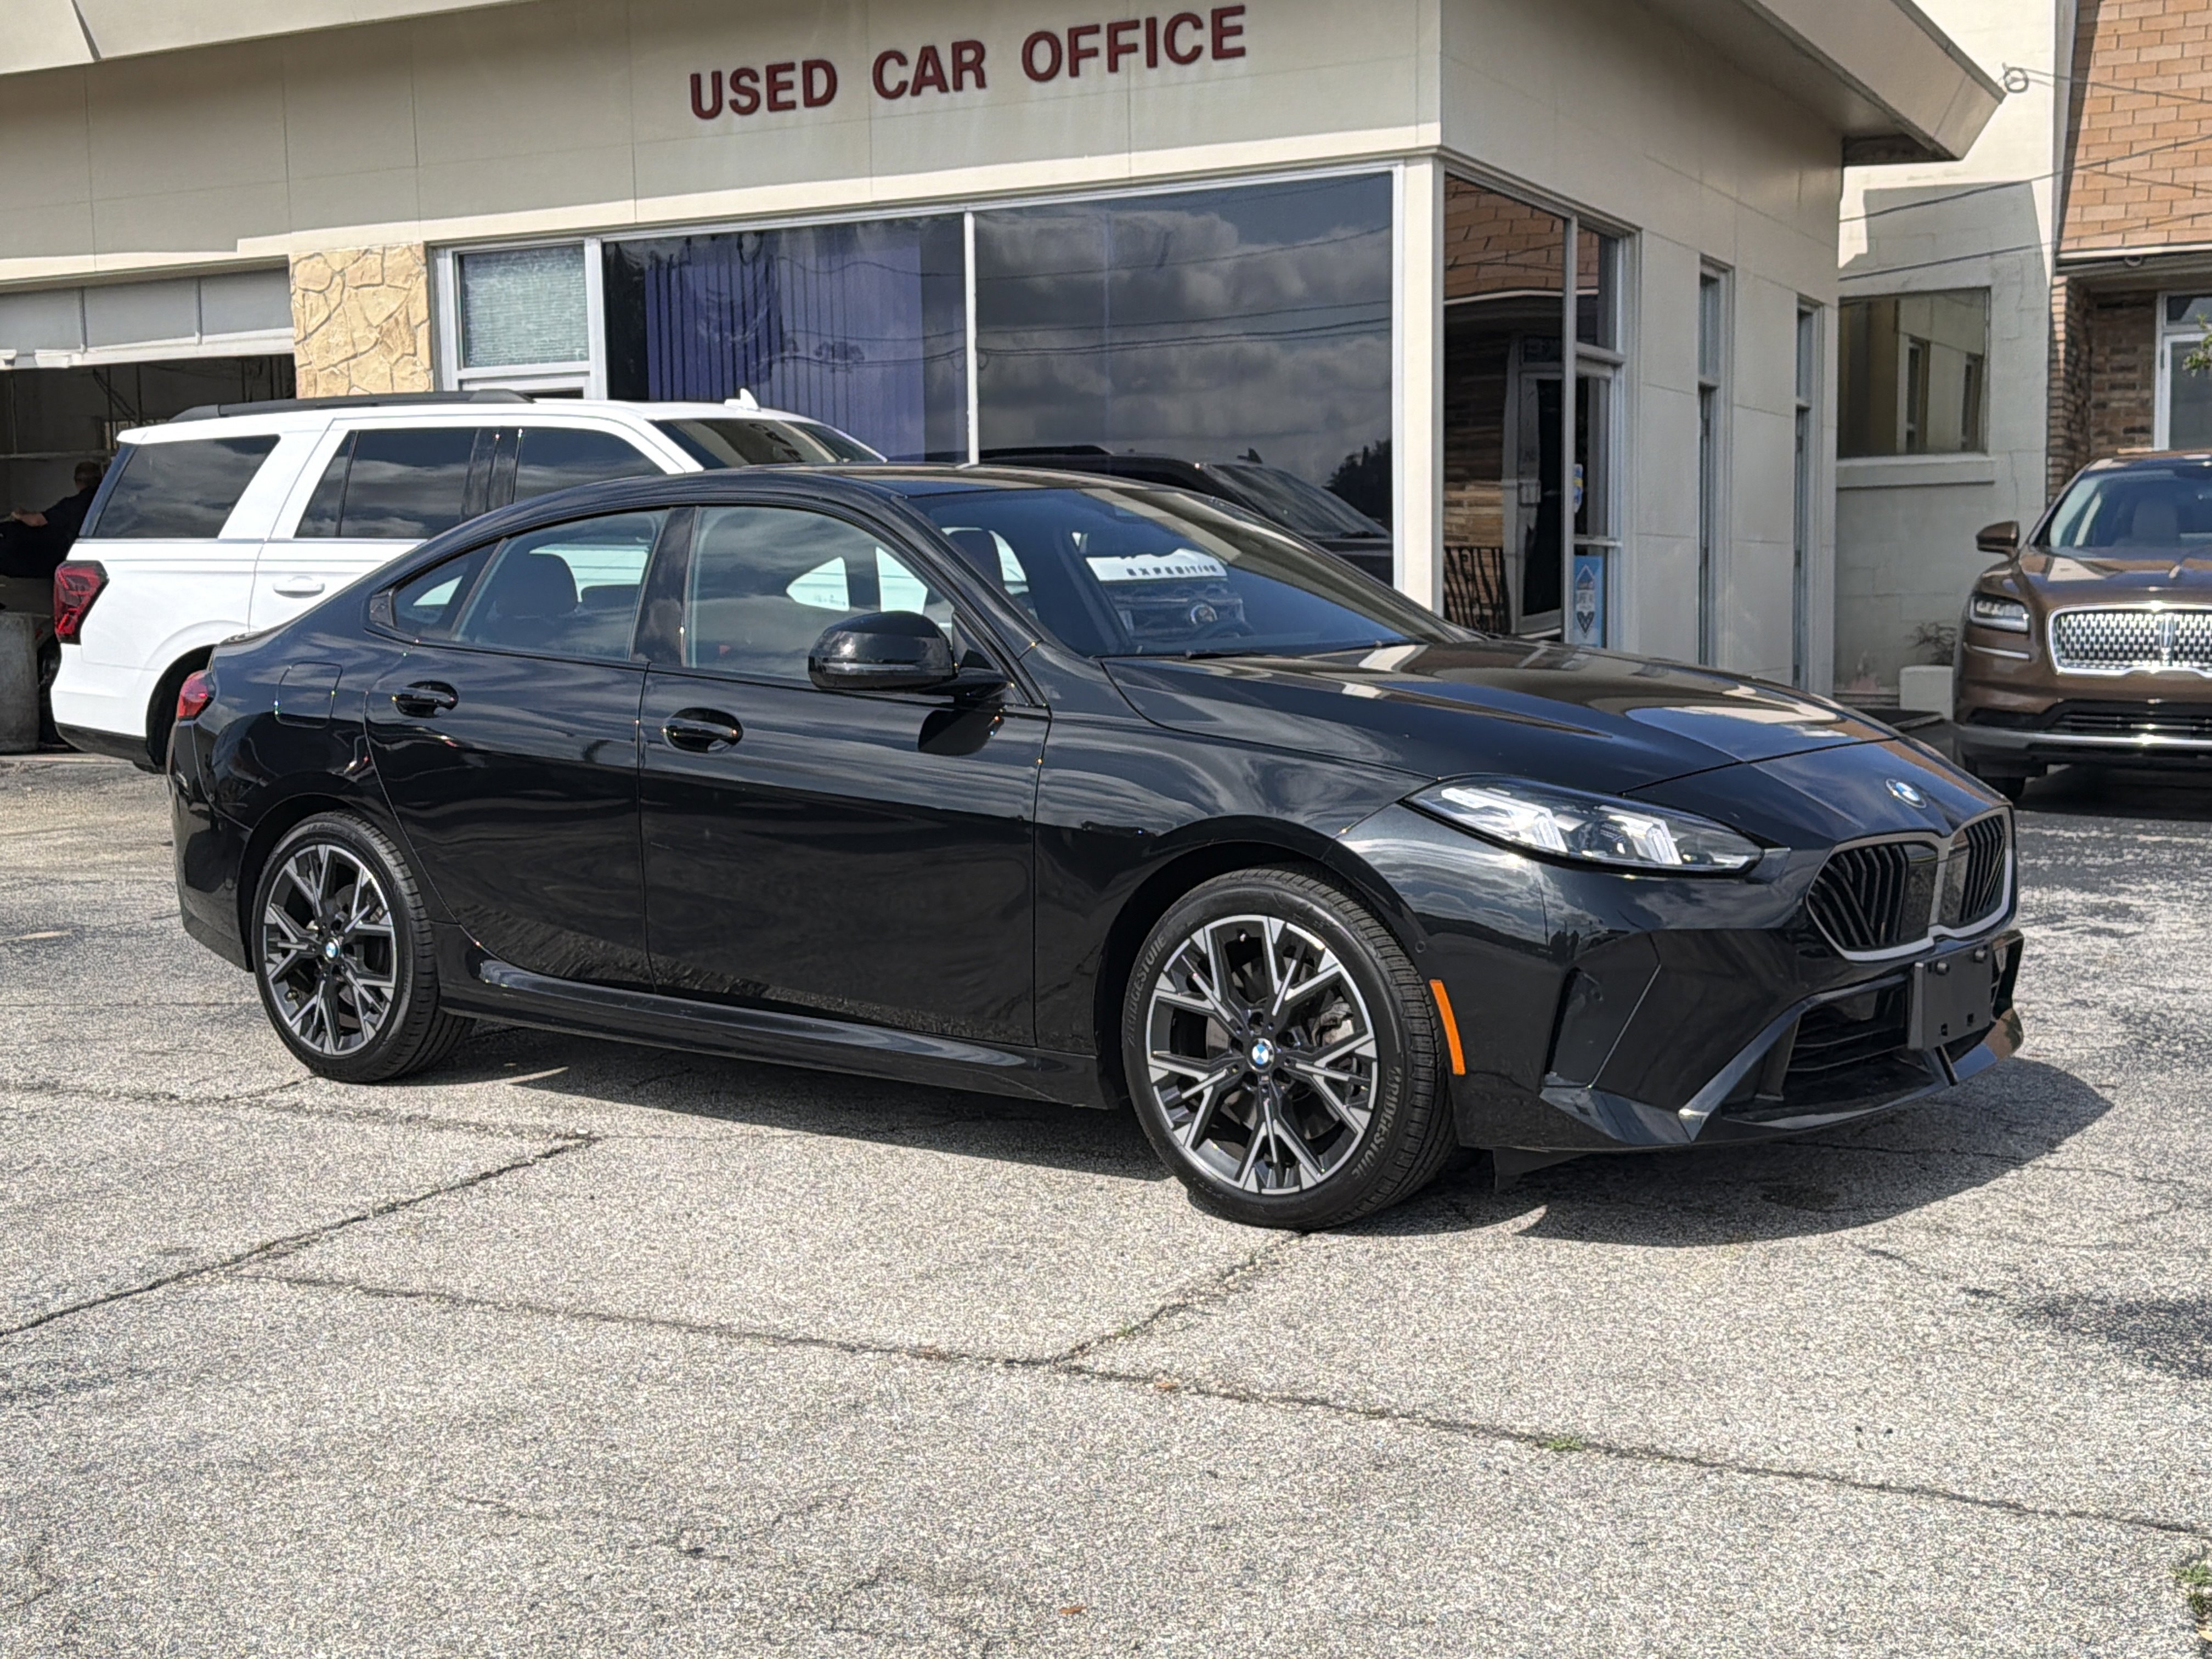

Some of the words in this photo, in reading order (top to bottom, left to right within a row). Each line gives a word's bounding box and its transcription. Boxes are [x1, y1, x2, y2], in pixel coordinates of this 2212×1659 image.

[690, 59, 838, 120] USED
[872, 40, 986, 99] CAR
[1022, 5, 1246, 82] OFFICE
